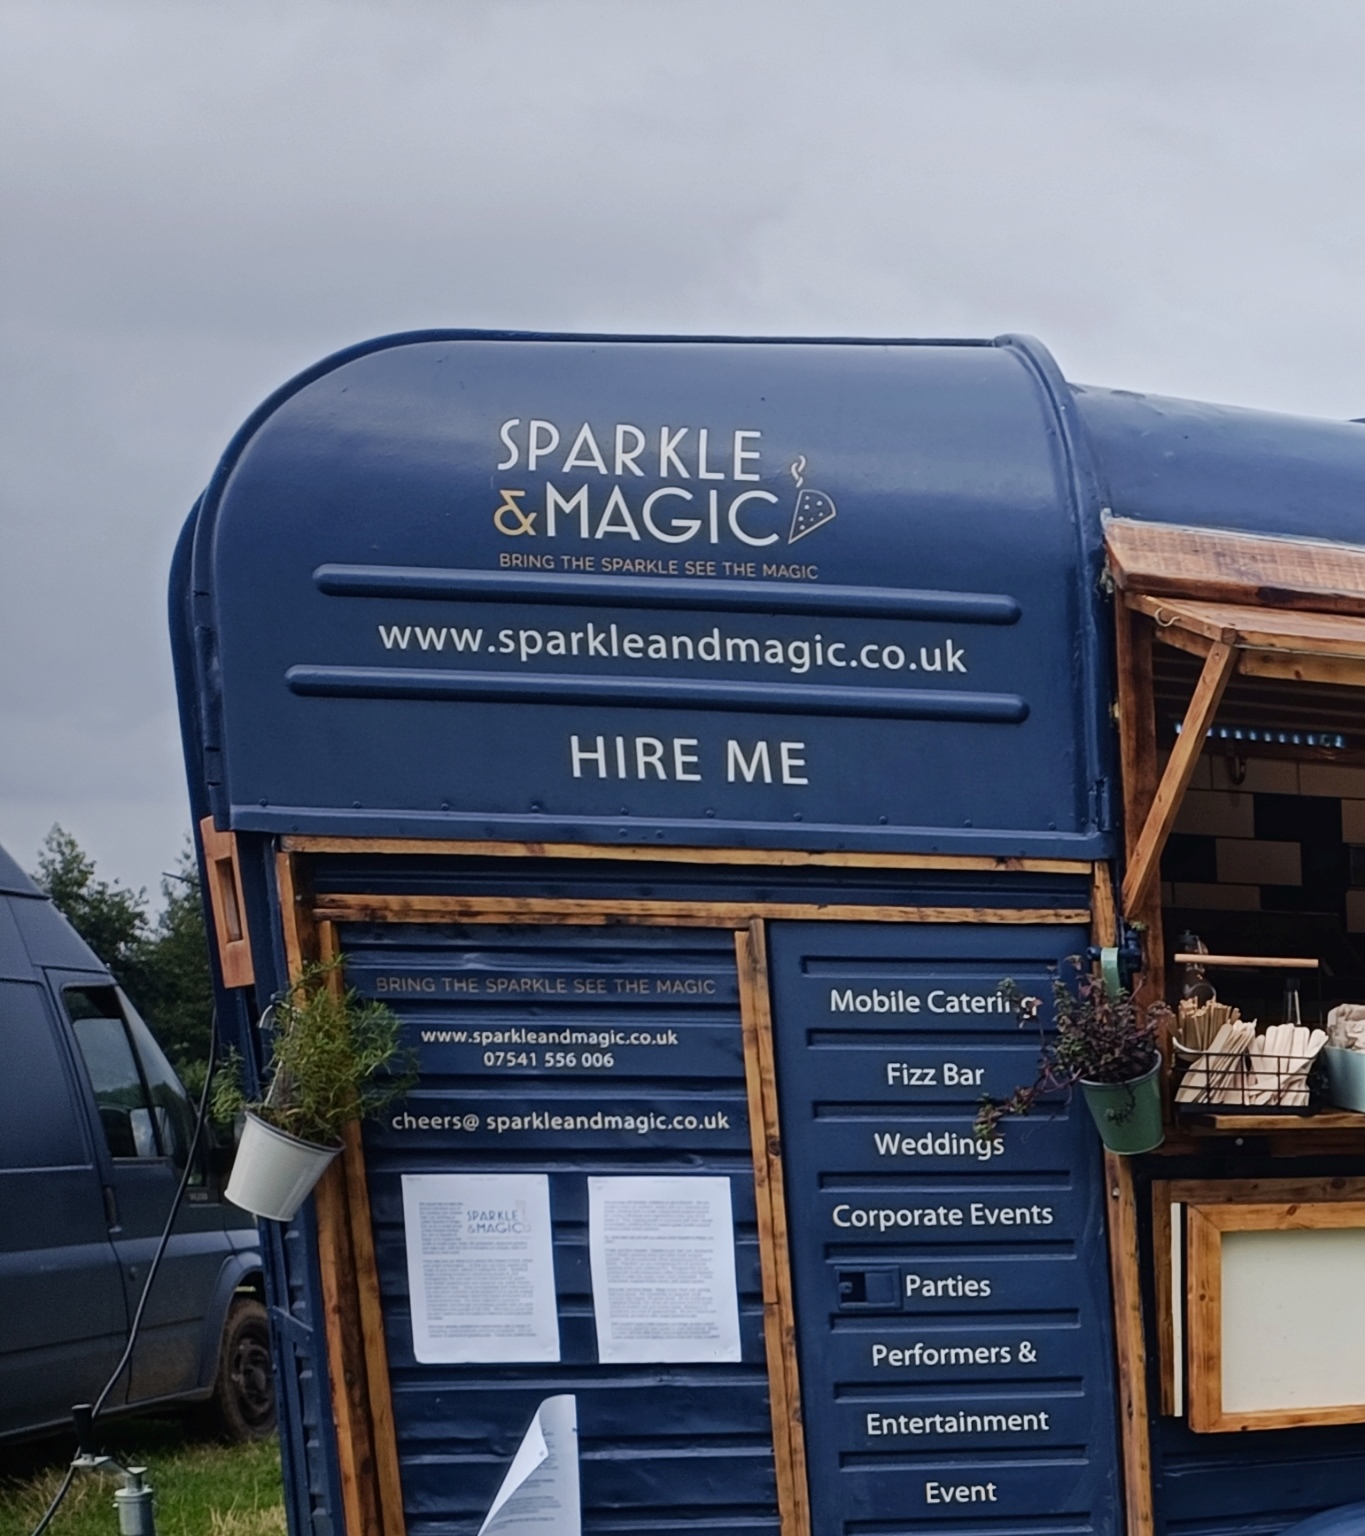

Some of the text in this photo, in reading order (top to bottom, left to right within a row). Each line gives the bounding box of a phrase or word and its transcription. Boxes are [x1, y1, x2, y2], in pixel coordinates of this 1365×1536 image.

[497, 418, 762, 482] SPARKLE
[500, 553, 818, 580] BRING THE SPARKLE SEE THE MAGIC
[378, 622, 967, 674] www.sparkleandmagic.co.uk
[570, 735, 809, 785] HIRE ME
[376, 977, 716, 995] BRING THE SPARKLE SEE THE MAGIC
[831, 990, 1037, 1019] Mobile Caterig
[421, 1027, 679, 1048] www.sparkleandmagic.co.uk
[483, 1051, 615, 1068] 07541 556 006
[887, 1062, 985, 1086] Fizz Bar
[392, 1111, 730, 1134] cheers@ sparkleandmagic.co.uk
[875, 1132, 1005, 1159] Weddings
[467, 1210, 518, 1222] SPARKLE
[832, 1202, 1053, 1233] Corporate Events
[906, 1274, 991, 1297] Parties
[872, 1341, 1037, 1367] Performers &
[866, 1411, 1050, 1435] Entertainment
[925, 1482, 998, 1504] Event
